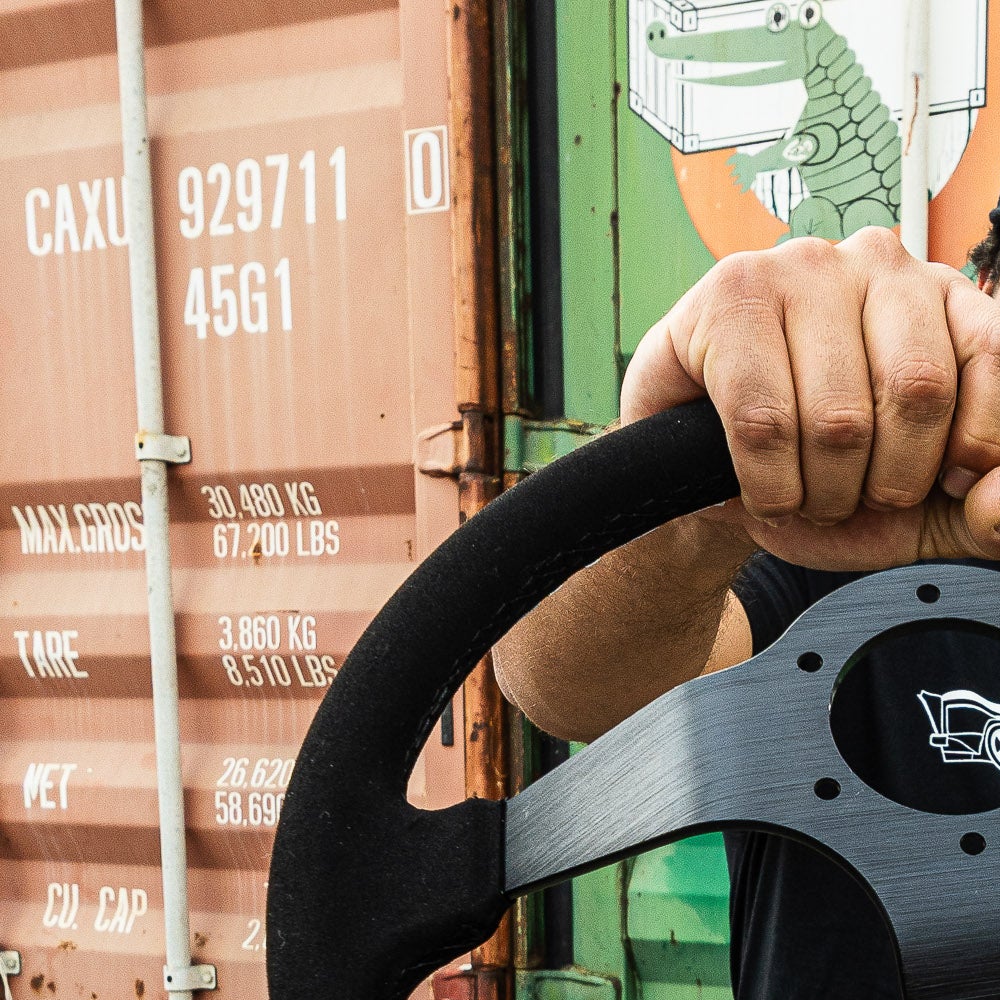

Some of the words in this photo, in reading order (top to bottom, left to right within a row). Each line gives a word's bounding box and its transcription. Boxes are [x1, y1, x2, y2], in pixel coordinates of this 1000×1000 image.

[24, 176, 129, 257] CAXU
[178, 146, 348, 240] 929711
[183, 256, 293, 339] 45G1
[284, 481, 322, 517] KG
[296, 520, 340, 556] LBS
[13, 630, 89, 679] TARE
[288, 615, 317, 651] KG
[291, 654, 339, 688] LBS
[23, 763, 78, 810] NET
[94, 886, 148, 935] CAP
